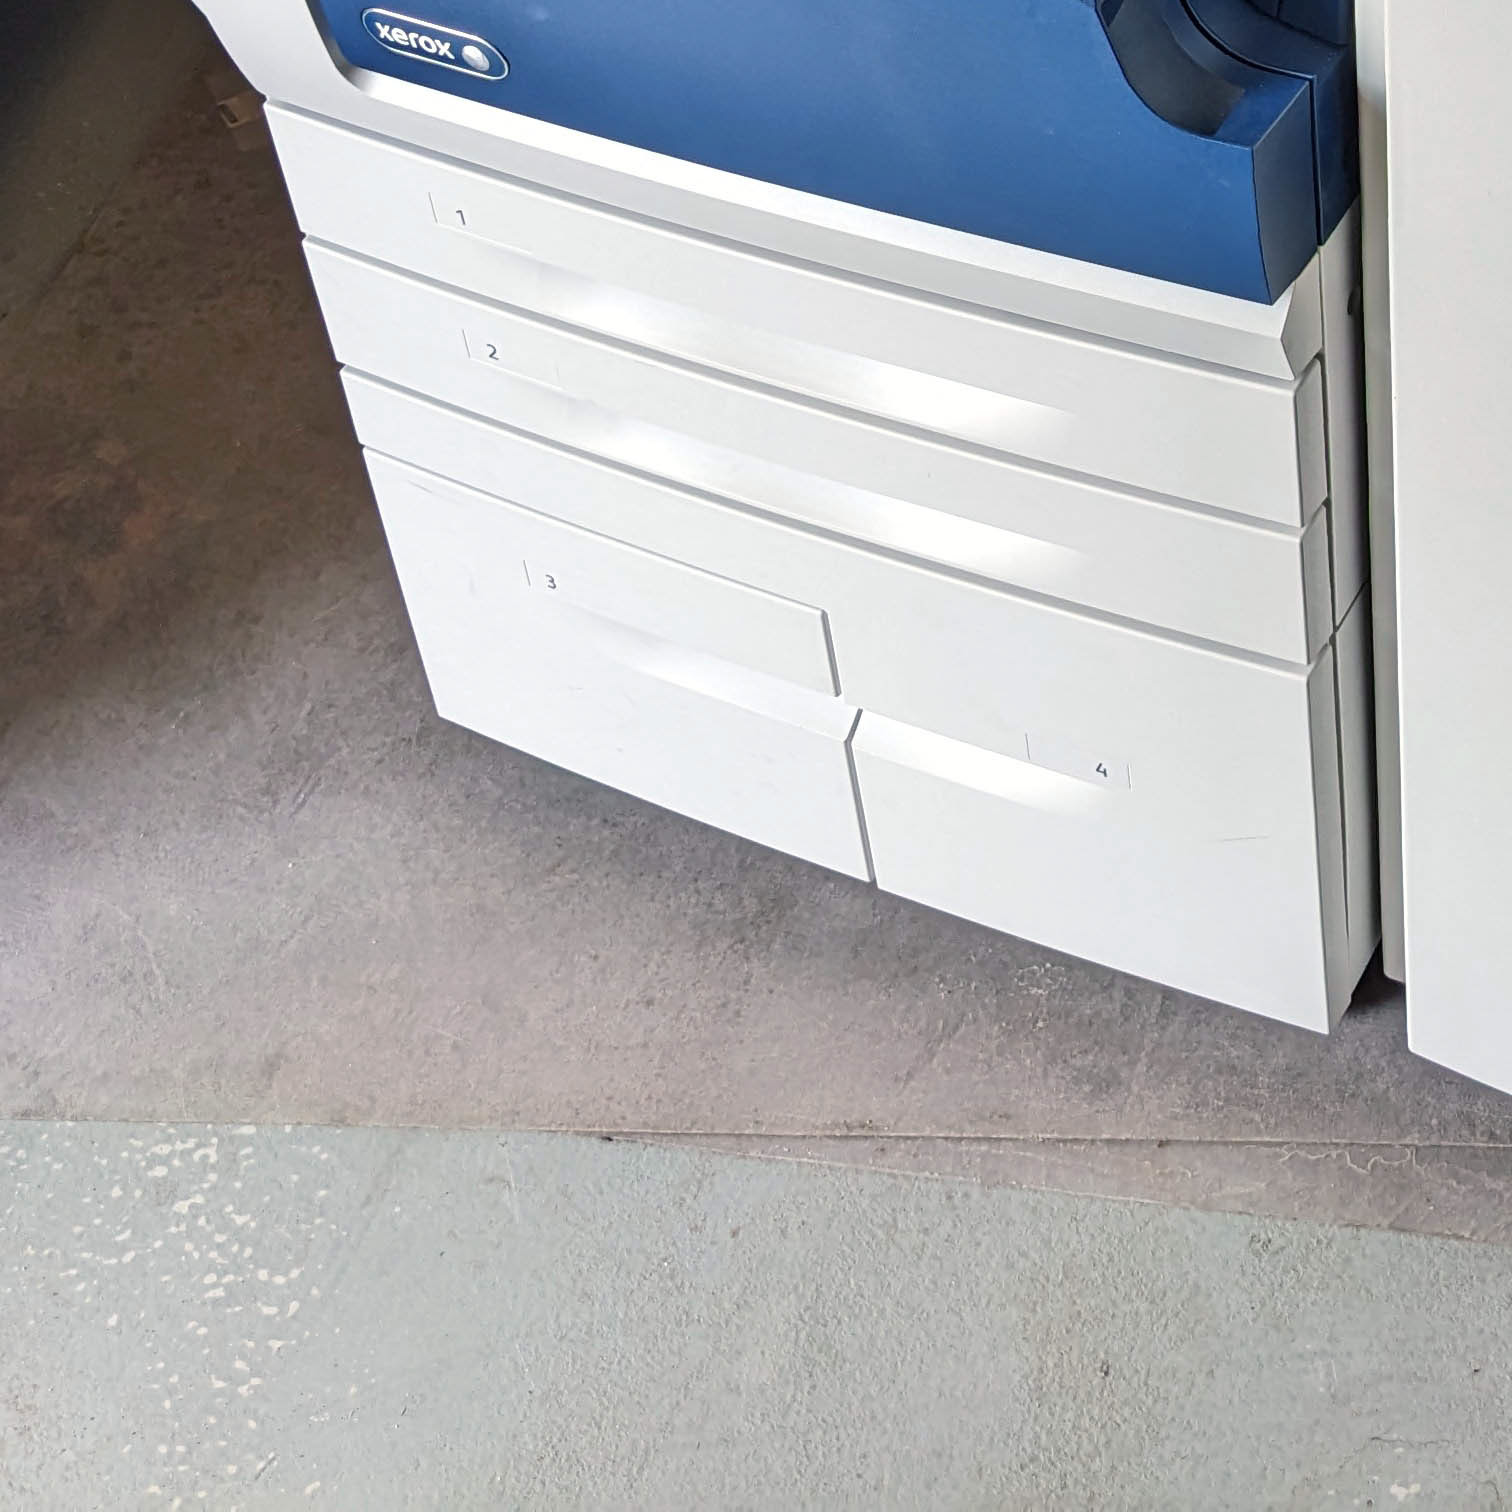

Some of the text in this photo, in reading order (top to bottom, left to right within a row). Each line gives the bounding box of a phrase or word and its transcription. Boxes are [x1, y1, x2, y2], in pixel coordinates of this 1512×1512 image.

[374, 21, 456, 61] xerox
[455, 209, 466, 226] 1
[486, 343, 500, 361] 2
[545, 574, 557, 590] 3
[1095, 762, 1108, 778] 4
